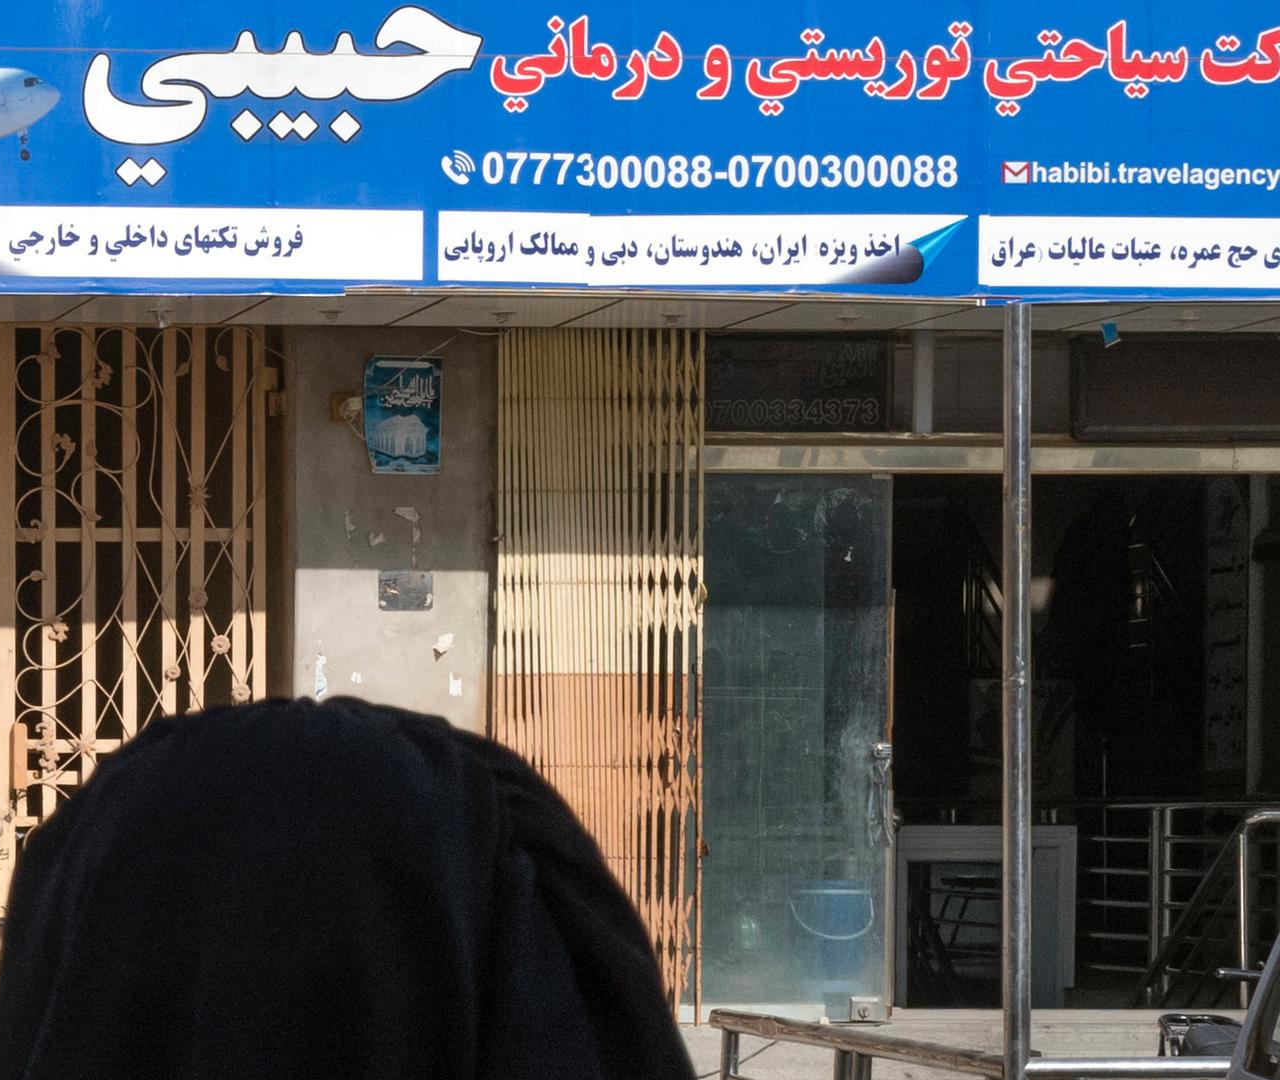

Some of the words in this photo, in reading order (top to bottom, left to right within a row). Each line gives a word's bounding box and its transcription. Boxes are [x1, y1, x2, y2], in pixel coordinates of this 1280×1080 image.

[490, 14, 683, 112] درماني
[696, 42, 733, 99] و
[82, 4, 484, 187] حبيبي
[481, 151, 958, 189] 0777300088-0700300088
[8, 223, 81, 262] خارجي
[88, 233, 99, 256] و
[105, 223, 168, 262] داخلي
[244, 224, 304, 257] فروش
[444, 230, 514, 263] اروپایی
[519, 231, 579, 256] ممالک
[585, 244, 595, 267] و
[601, 238, 639, 267] دبی
[646, 233, 743, 266] هندوستان،
[752, 233, 807, 265] ایران،
[864, 232, 900, 258] اخذ
[1048, 235, 1106, 267] عالیات
[1111, 236, 1162, 267] عتبات
[1170, 243, 1222, 268] عمره،
[1227, 244, 1258, 268] حج
